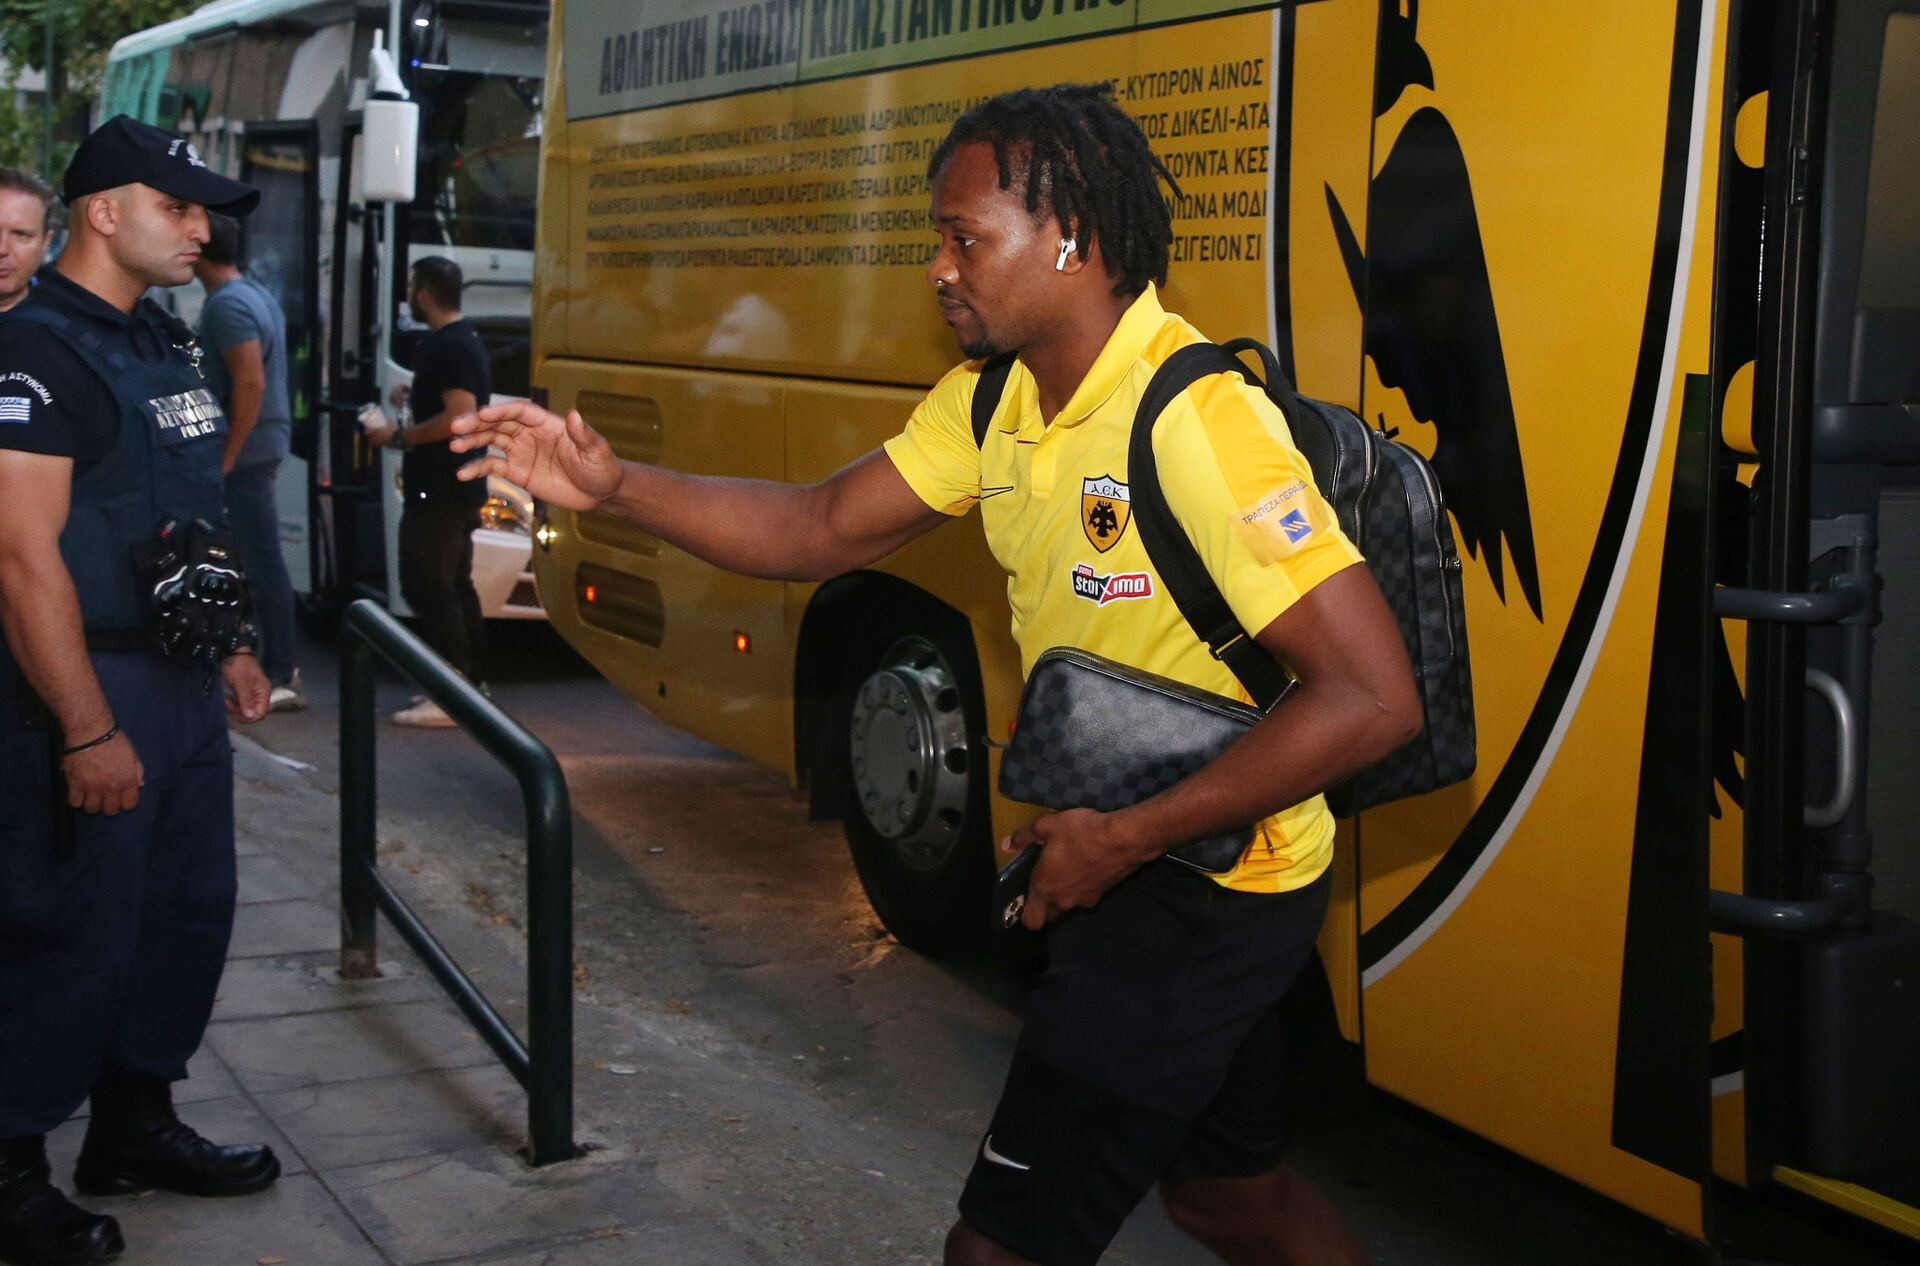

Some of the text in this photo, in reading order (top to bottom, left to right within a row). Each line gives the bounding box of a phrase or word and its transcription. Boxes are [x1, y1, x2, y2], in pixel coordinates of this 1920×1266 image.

[600, 14, 708, 96] ΑΘΛΗΤΙΚΗ
[715, 0, 800, 76] ΕΝΩΣΙΣ
[1208, 59, 1263, 91] ΑΙΝΟΣ
[869, 99, 961, 131] ΑΔΡΙΑΝΟΥΠΟΛΗ
[1171, 102, 1270, 137] ΔΙΚΕΛΙ-ΑΤΑ
[1234, 146, 1269, 174] ΚΕΣ
[1222, 190, 1266, 217] ΜΟΔΙ
[858, 209, 925, 233] ΜΕΝΕΜΕΝΗ
[1173, 234, 1261, 261] ΣΙΓΕΙΟΝ ΣΙ
[8, 371, 55, 406] ΑΣΤΥΝΟΜΙΑ
[1241, 498, 1280, 525] ΤΡΑΠΕΖΑ
